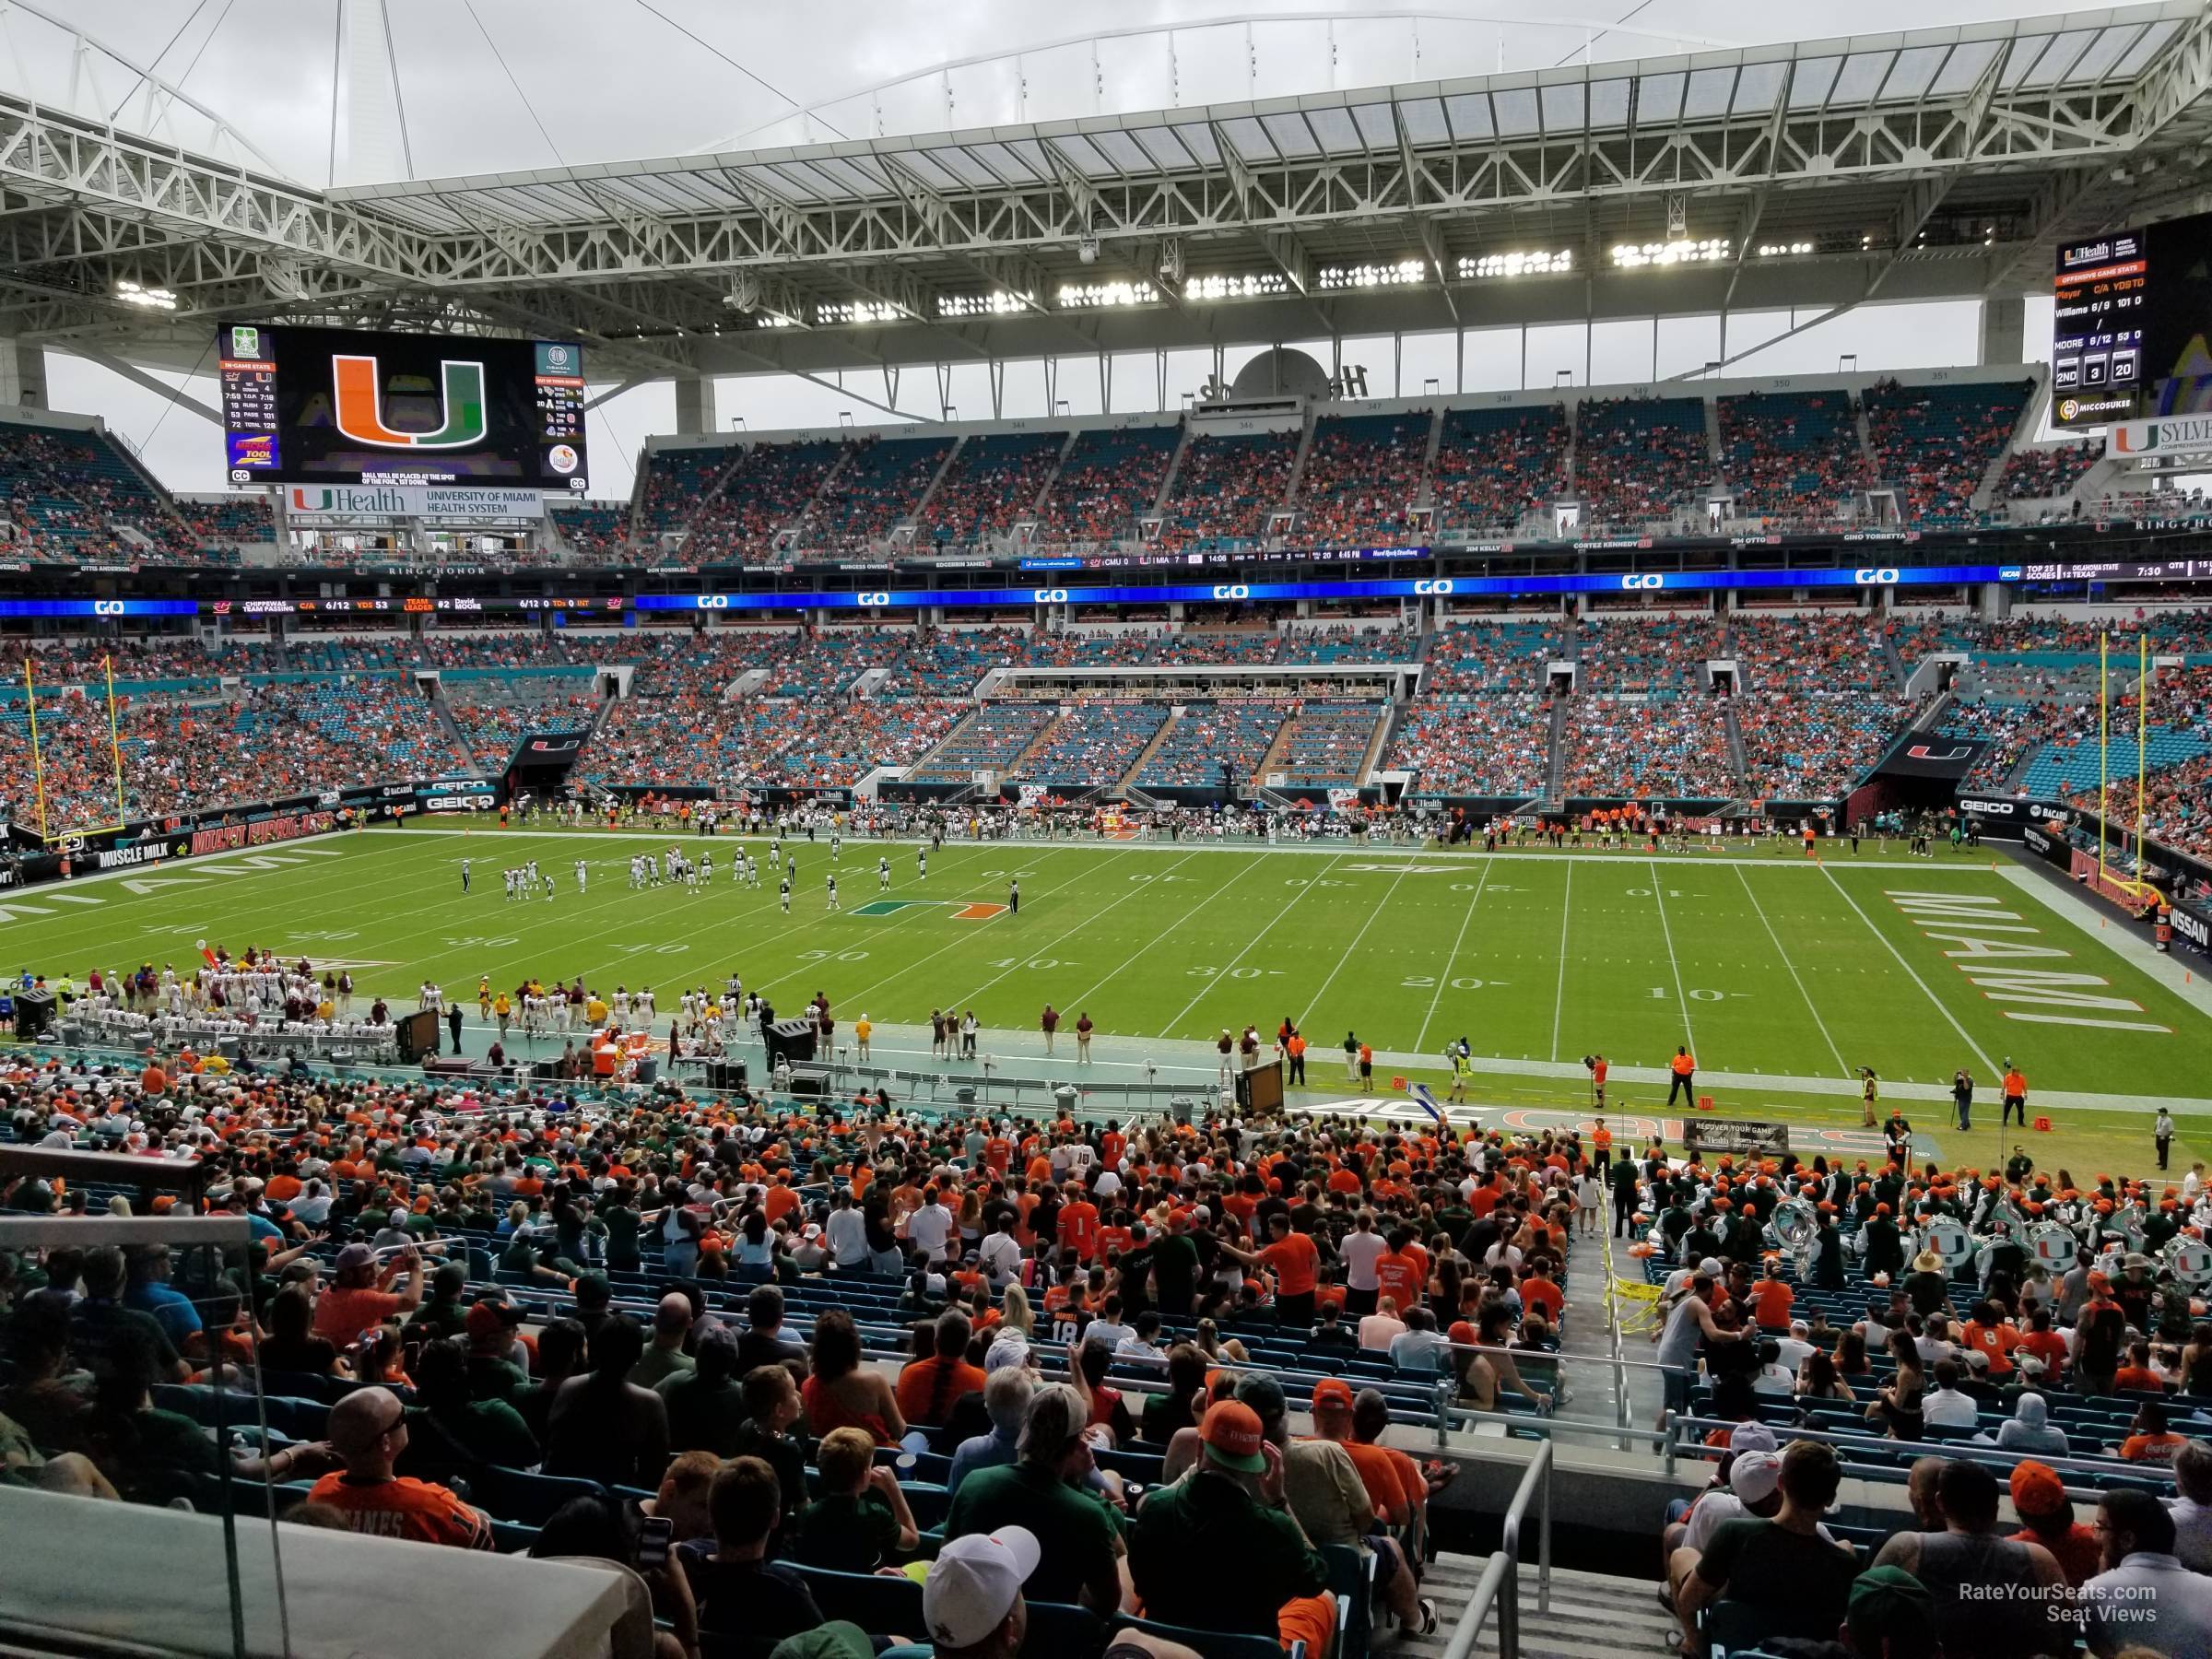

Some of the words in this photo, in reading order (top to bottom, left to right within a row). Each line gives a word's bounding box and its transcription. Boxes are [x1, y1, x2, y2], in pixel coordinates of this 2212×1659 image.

[2062, 272, 2097, 284] OFFENSIVE
[2098, 268, 2116, 277] GAME
[2117, 265, 2138, 275] STATS
[2056, 289, 2081, 300] Player
[2094, 284, 2110, 294] C/A
[2113, 280, 2132, 291] YDS
[2133, 278, 2145, 288] TD
[2055, 306, 2088, 318] Williams
[2117, 297, 2131, 308] 101
[2135, 295, 2142, 305] 0
[2054, 337, 2084, 350] MOORE
[2089, 334, 2112, 347] 6/12
[2117, 332, 2130, 342] 53
[2134, 329, 2142, 339] 0
[1932, 372, 1947, 381] 351
[2056, 371, 2077, 383] 2ND
[2091, 368, 2100, 380] 3
[2115, 364, 2131, 377] 20
[1773, 380, 1790, 388] 350
[333, 354, 487, 448] U
[1496, 394, 1512, 404] 348
[2079, 399, 2131, 412] MICCOSUKEE
[1367, 403, 1382, 411] 347
[1239, 421, 1254, 429] 346
[246, 450, 272, 458] TOOL
[233, 472, 249, 480] CC
[571, 479, 584, 488] CC
[427, 490, 486, 501] UNIVERSITY
[488, 491, 501, 501] OF
[502, 492, 536, 503] MIAMI
[427, 502, 466, 512] HEALTH
[467, 503, 508, 513] SYSTEM
[2136, 520, 2177, 530] RING
[1603, 540, 1638, 548] KENNEDY
[1105, 558, 1122, 566] CMU
[1124, 557, 1129, 565] 0
[1156, 556, 1170, 564] MIA
[1209, 554, 1227, 562] 14:06
[1323, 551, 1332, 559] 20
[1339, 550, 1350, 559] 4:45
[1351, 550, 1360, 559] PM
[389, 567, 423, 576] RING
[436, 567, 486, 575] HONOR
[2073, 564, 2101, 572] OKLAHOMA
[2101, 563, 2120, 571] STATE
[2137, 567, 2161, 577] 7:30
[2169, 561, 2185, 570] QTR
[2197, 560, 2208, 569] 15
[1622, 574, 1664, 589] GO
[1854, 568, 1900, 584] GO
[2027, 572, 2056, 581] SCORES
[2073, 571, 2097, 579] TEXAS
[1213, 584, 1249, 599] GO
[1414, 580, 1453, 594] GO
[698, 595, 728, 608] GO
[857, 593, 890, 606] GO
[1034, 589, 1068, 603] GO
[95, 600, 124, 615] GO
[299, 602, 315, 610] C/A
[325, 601, 350, 610] 6/12
[357, 601, 373, 609] YDS
[375, 601, 388, 609] 53
[404, 604, 433, 612] LEADER
[438, 601, 450, 609] #2
[520, 600, 539, 608] 6/12
[543, 600, 549, 608] 0
[568, 600, 574, 608] 0
[1407, 798, 1442, 807] UHealth
[1960, 799, 2014, 814] GEICO
[100, 846, 142, 868] MUSCLE
[144, 842, 169, 861] MILK
[2170, 909, 2208, 947] NISSAN
[1884, 890, 2173, 1034] MIAMI
[1400, 975, 1483, 990] 20
[1644, 986, 1724, 1002] 10
[1394, 1077, 1404, 1088] 20
[1285, 1098, 1500, 1125] ACC
[1696, 1123, 1729, 1131] RECOVER
[2040, 1117, 2049, 1131] G
[1112, 1141, 1118, 1154] 1
[1076, 1217, 1084, 1237] 1
[1052, 1321, 1078, 1343] 18
[1985, 1330, 1998, 1347] 8
